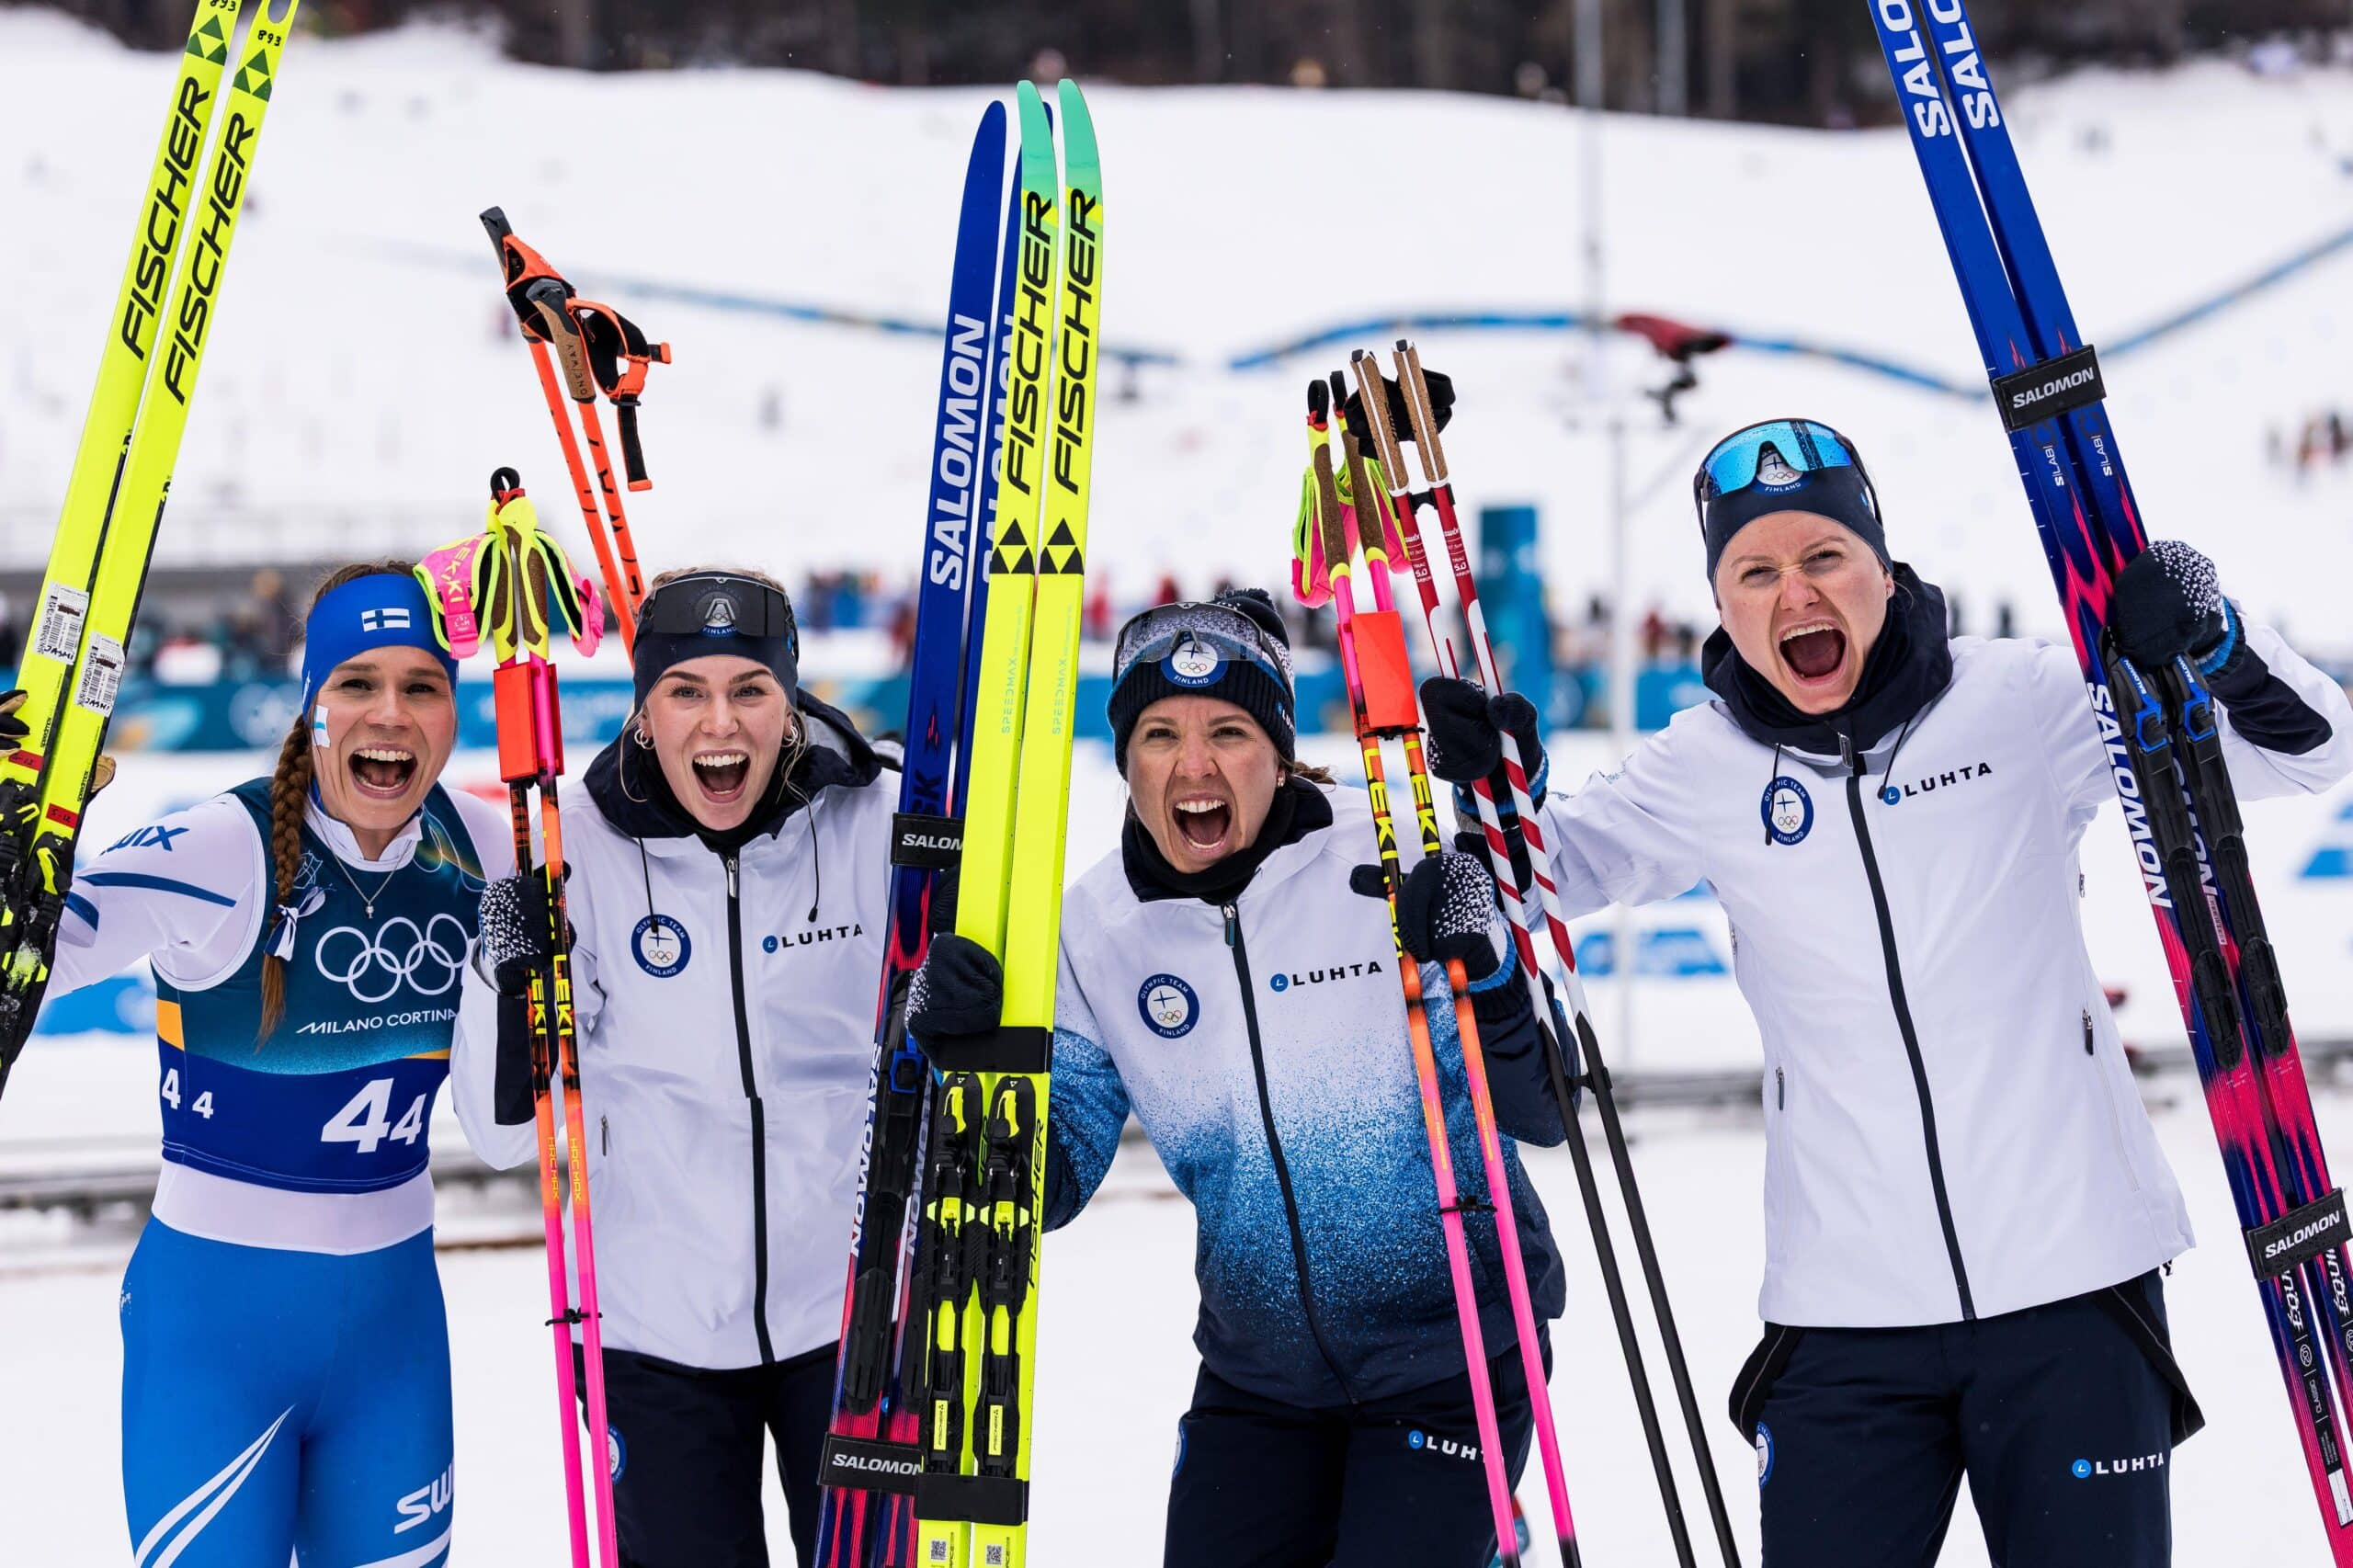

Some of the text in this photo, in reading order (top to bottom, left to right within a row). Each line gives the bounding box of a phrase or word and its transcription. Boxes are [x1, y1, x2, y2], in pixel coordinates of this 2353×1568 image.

[258, 29, 282, 47] 893
[120, 76, 210, 361] FISCHER
[165, 112, 255, 406] FISCHER
[1006, 190, 1053, 496] FISCHER
[1054, 187, 1097, 496] FISCHER
[2012, 367, 2095, 409] SALOMON
[928, 312, 986, 591] SALOMON
[1764, 482, 1802, 493] FINLAND
[1173, 675, 1210, 686] FINLAND
[1404, 739, 1441, 853] LEKI
[1904, 762, 1993, 798] LUHTA
[2086, 681, 2173, 908] SALOMON
[1363, 747, 1400, 860] LEKI
[1777, 830, 1804, 844] FINLAND
[781, 924, 863, 948] LUHTA
[645, 964, 677, 976] FINLAND
[1141, 978, 1189, 1000] OLYMPIC TEAM
[1292, 961, 1382, 986] LUHTA
[531, 969, 547, 1035] EKI
[553, 954, 574, 1035] LEKI
[296, 1015, 383, 1035] MILANO
[1159, 1023, 1191, 1037] FINLAND
[162, 1068, 214, 1119] 4 4
[321, 1078, 426, 1153] 4 4
[850, 1042, 881, 1257] SALOMON
[2264, 1210, 2342, 1259] SALOMON
[2308, 1378, 2323, 1416] CLASSIC
[1426, 1436, 1485, 1464] LUH
[2096, 1454, 2164, 1475] LUHTA
